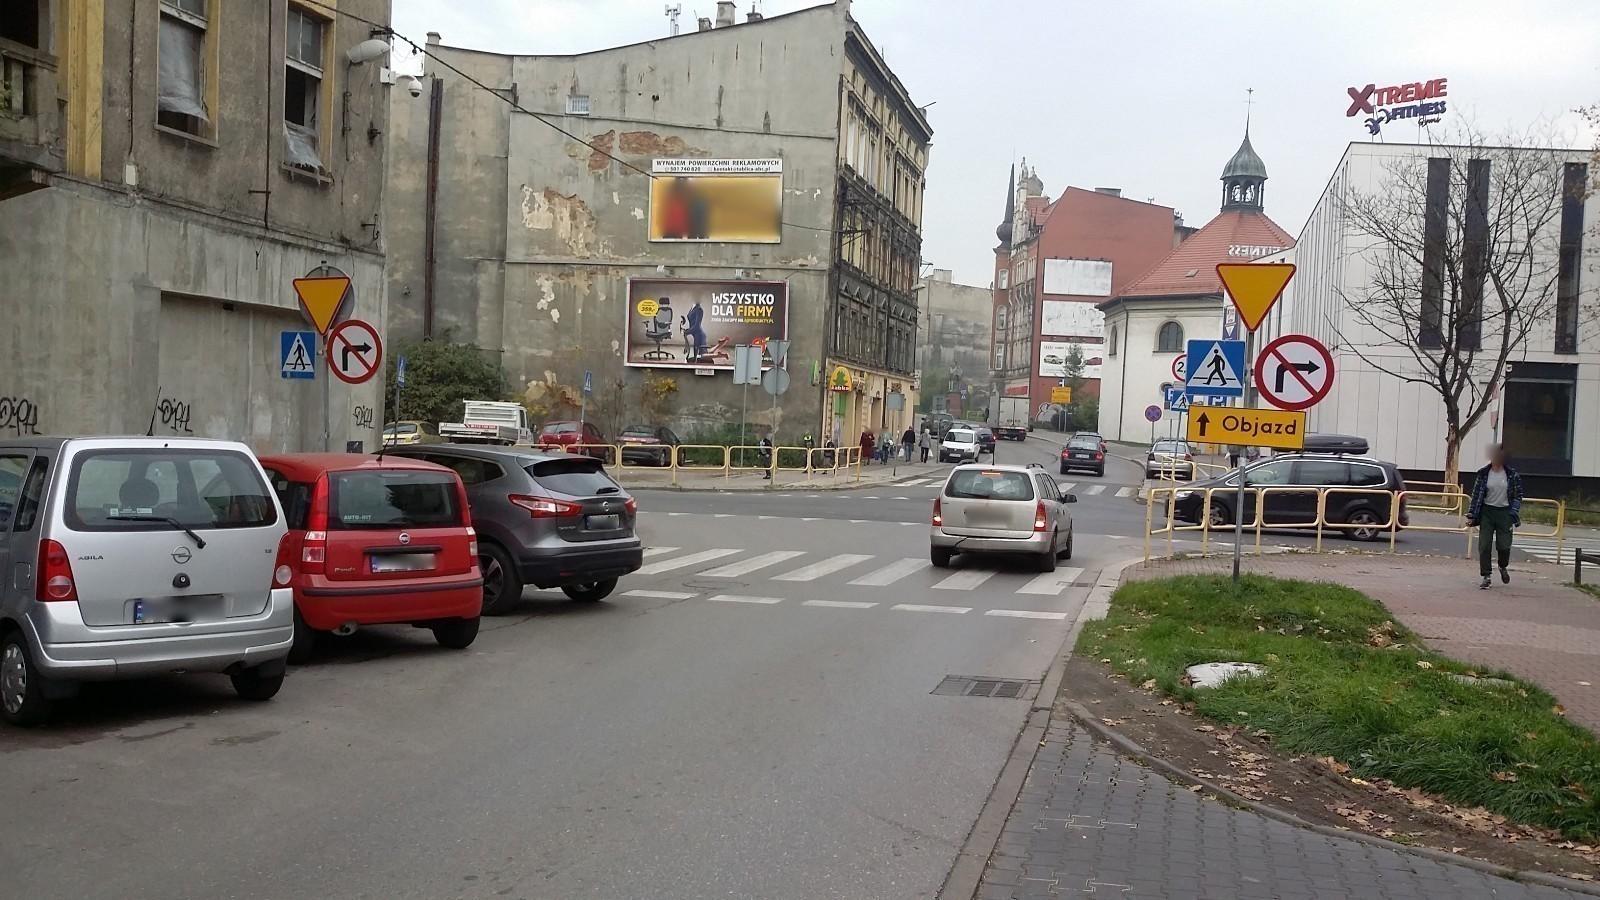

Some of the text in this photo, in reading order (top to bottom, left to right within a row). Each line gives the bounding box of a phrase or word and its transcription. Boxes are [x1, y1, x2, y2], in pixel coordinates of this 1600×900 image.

[1346, 78, 1448, 118] XTREME
[1391, 101, 1446, 121] FITNESS
[712, 293, 775, 305] WSZYSTKO
[712, 305, 774, 317] DLA FIRMY
[1222, 415, 1297, 438] Objazd
